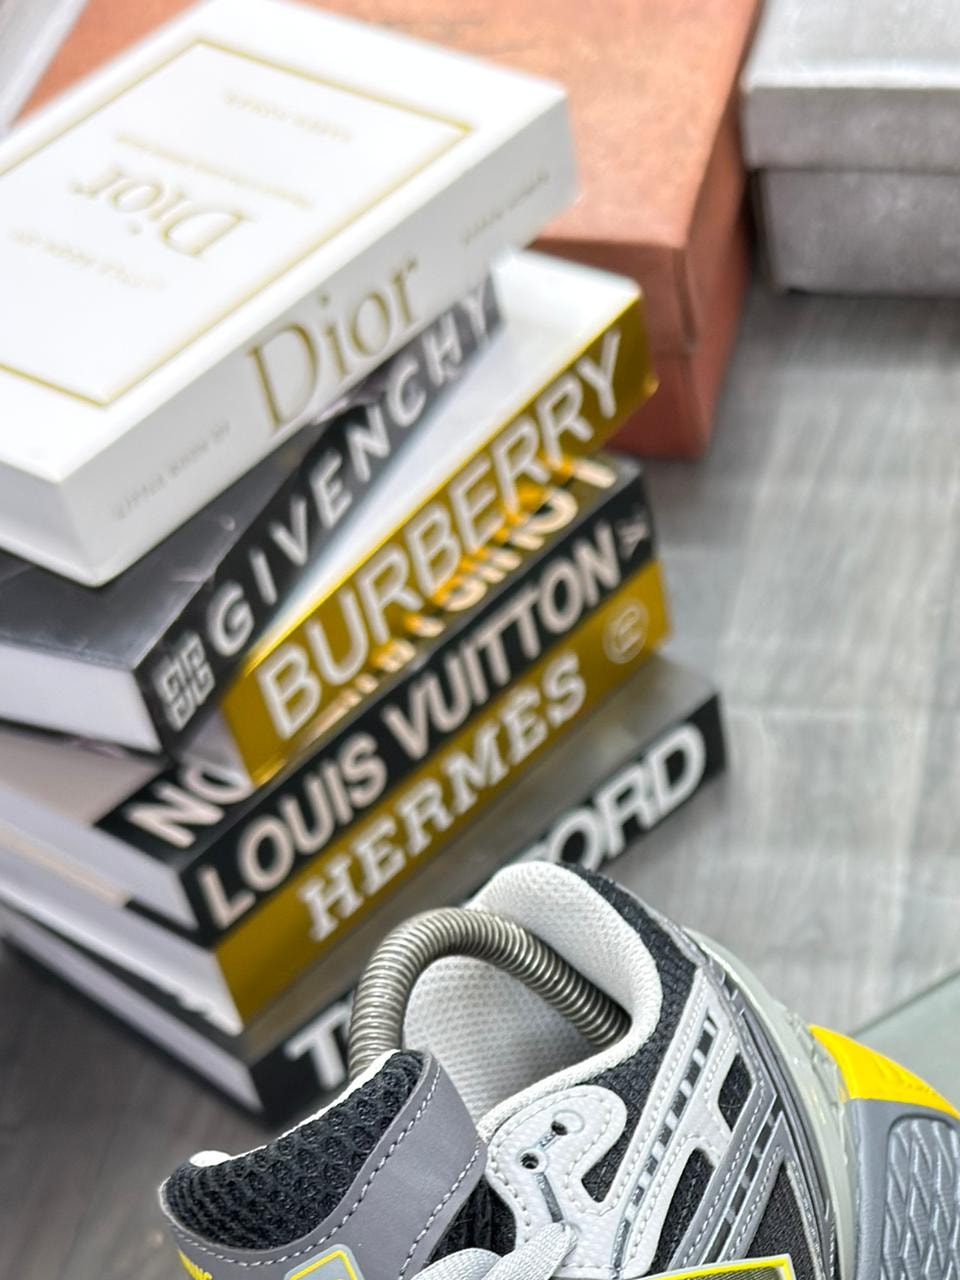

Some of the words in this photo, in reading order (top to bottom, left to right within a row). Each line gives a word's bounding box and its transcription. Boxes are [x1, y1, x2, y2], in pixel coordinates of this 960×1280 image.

[70, 163, 254, 258] Dior
[247, 258, 418, 430] Dior
[206, 278, 494, 658] GIVENCHY
[255, 333, 624, 742] BURBERRY
[198, 731, 389, 930] LOUIS
[381, 518, 622, 762] VUITTON
[517, 722, 708, 872] ORD
